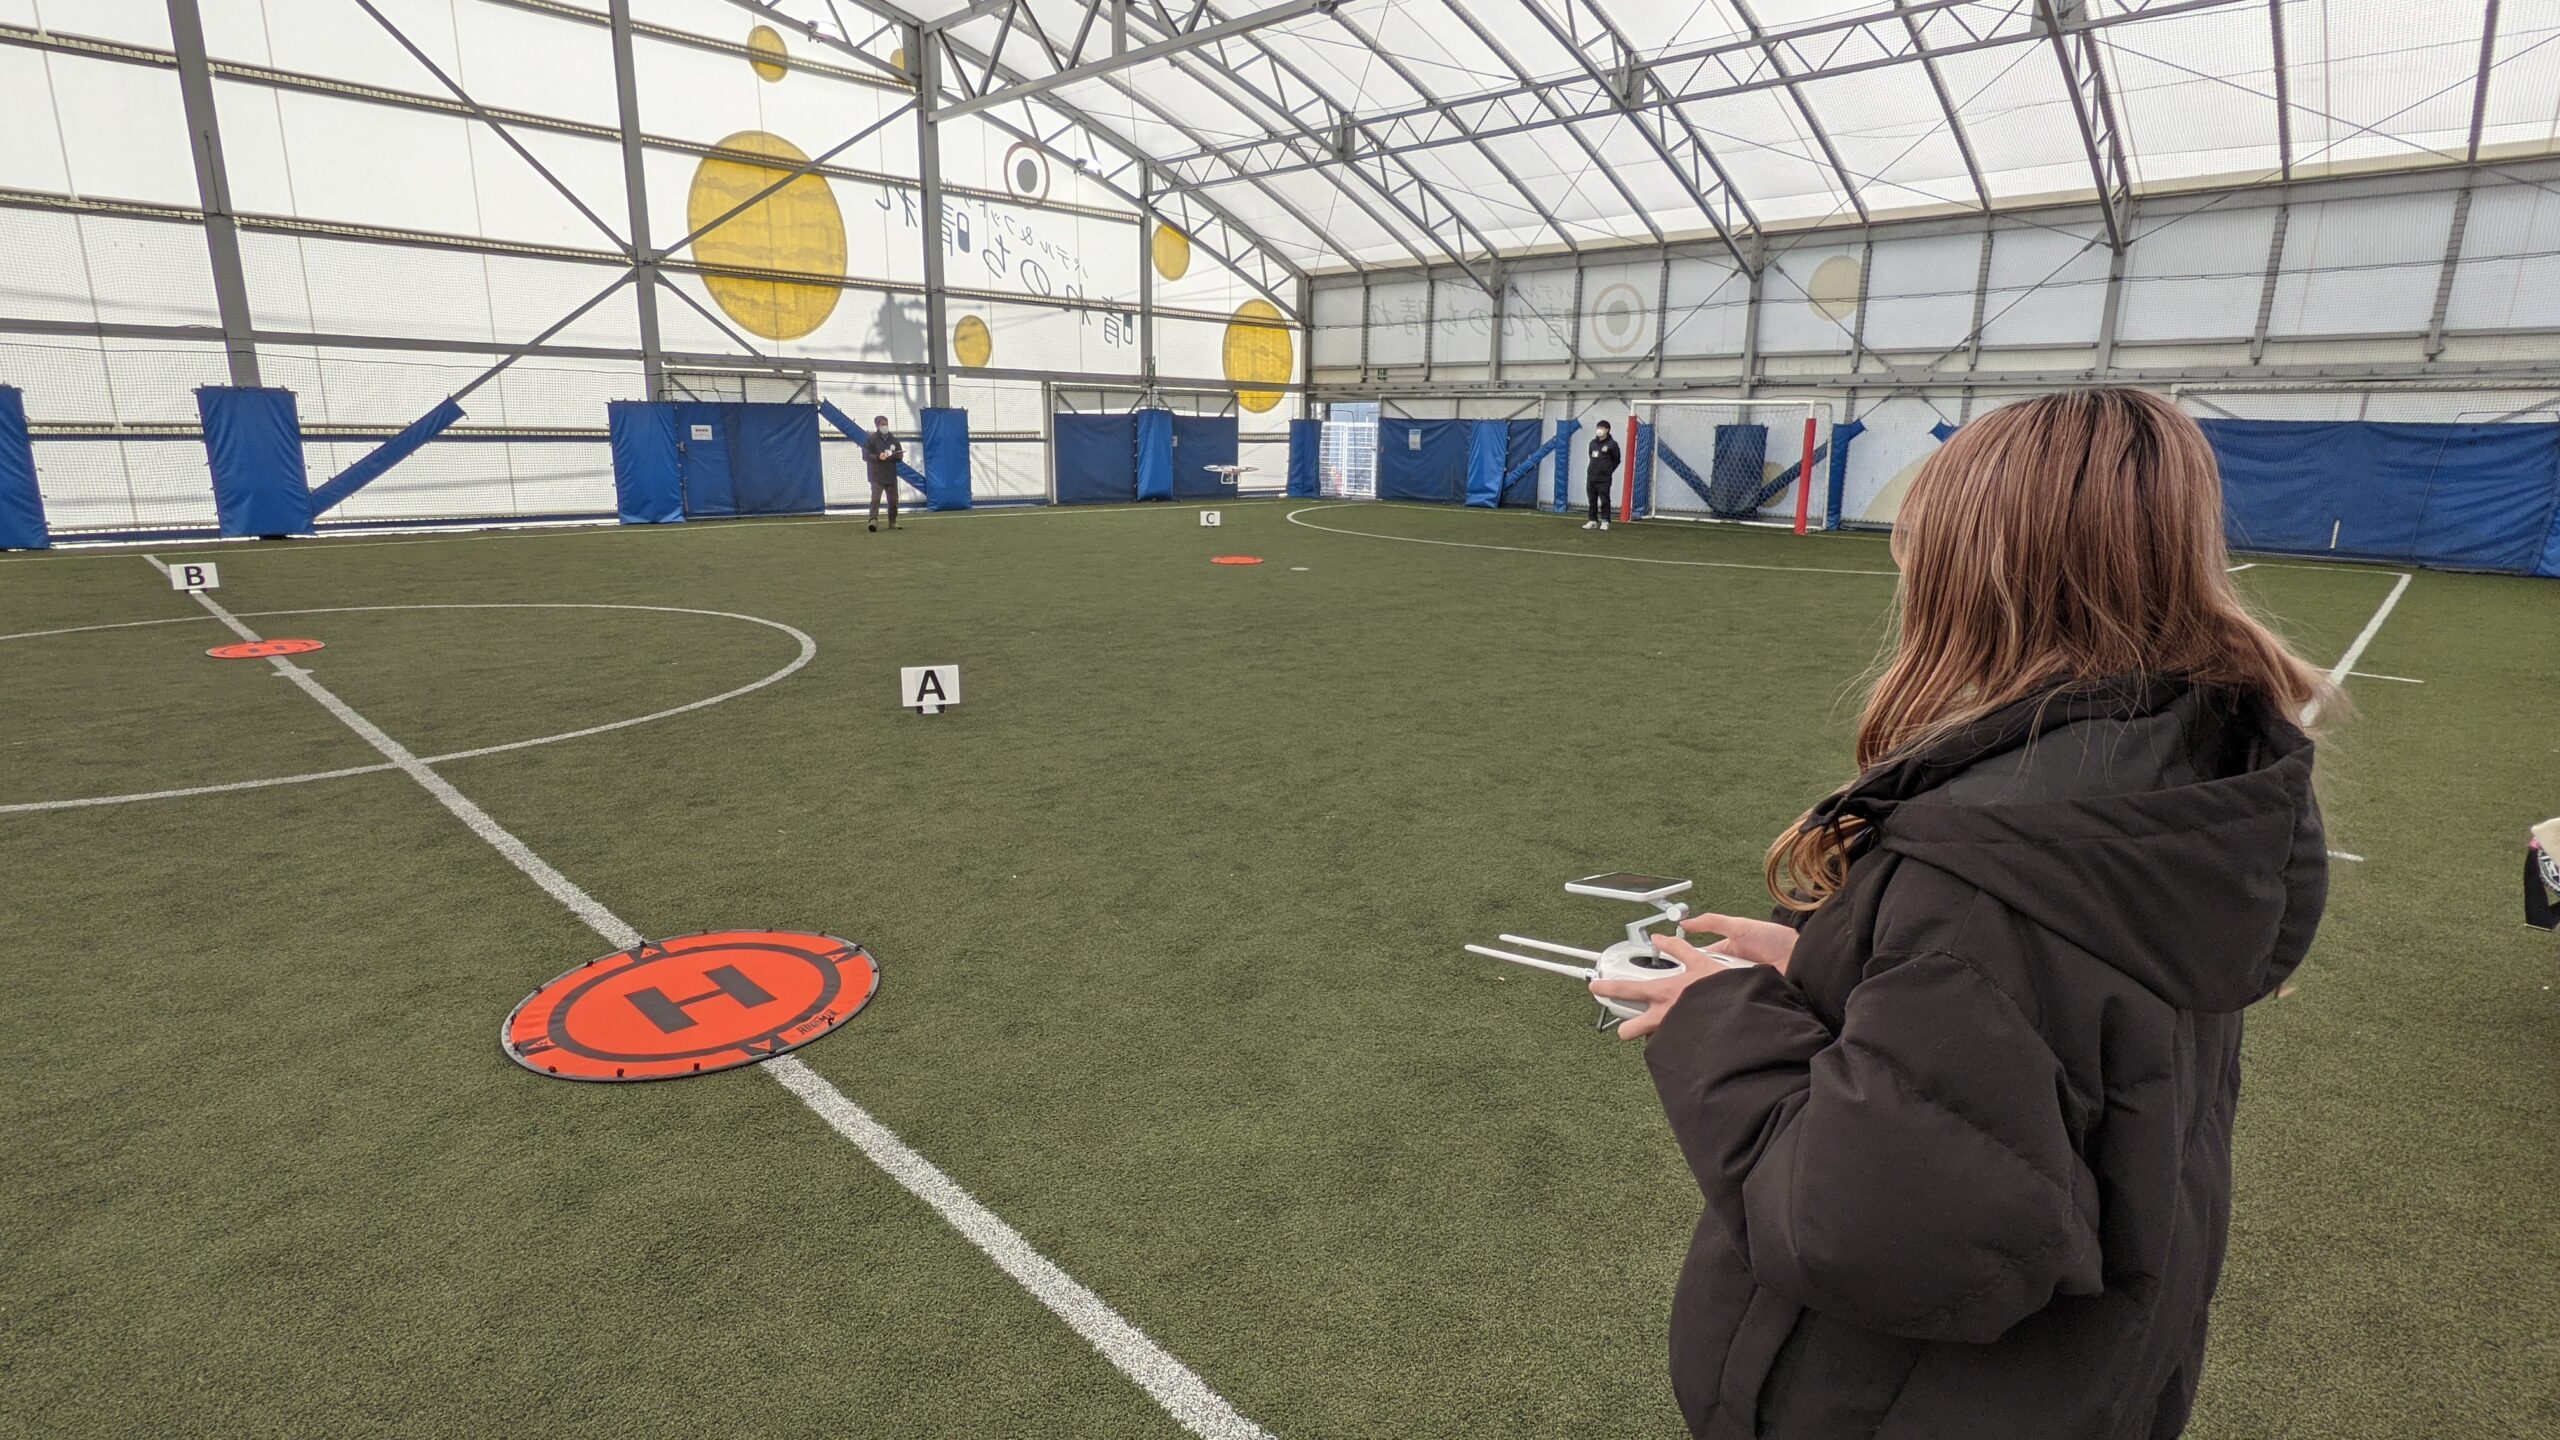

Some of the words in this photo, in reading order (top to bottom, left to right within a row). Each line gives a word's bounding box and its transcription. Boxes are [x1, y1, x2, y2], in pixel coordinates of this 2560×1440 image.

[1206, 512, 1215, 525] C
[184, 566, 206, 587] B
[916, 669, 947, 703] A
[623, 963, 778, 1035] H
